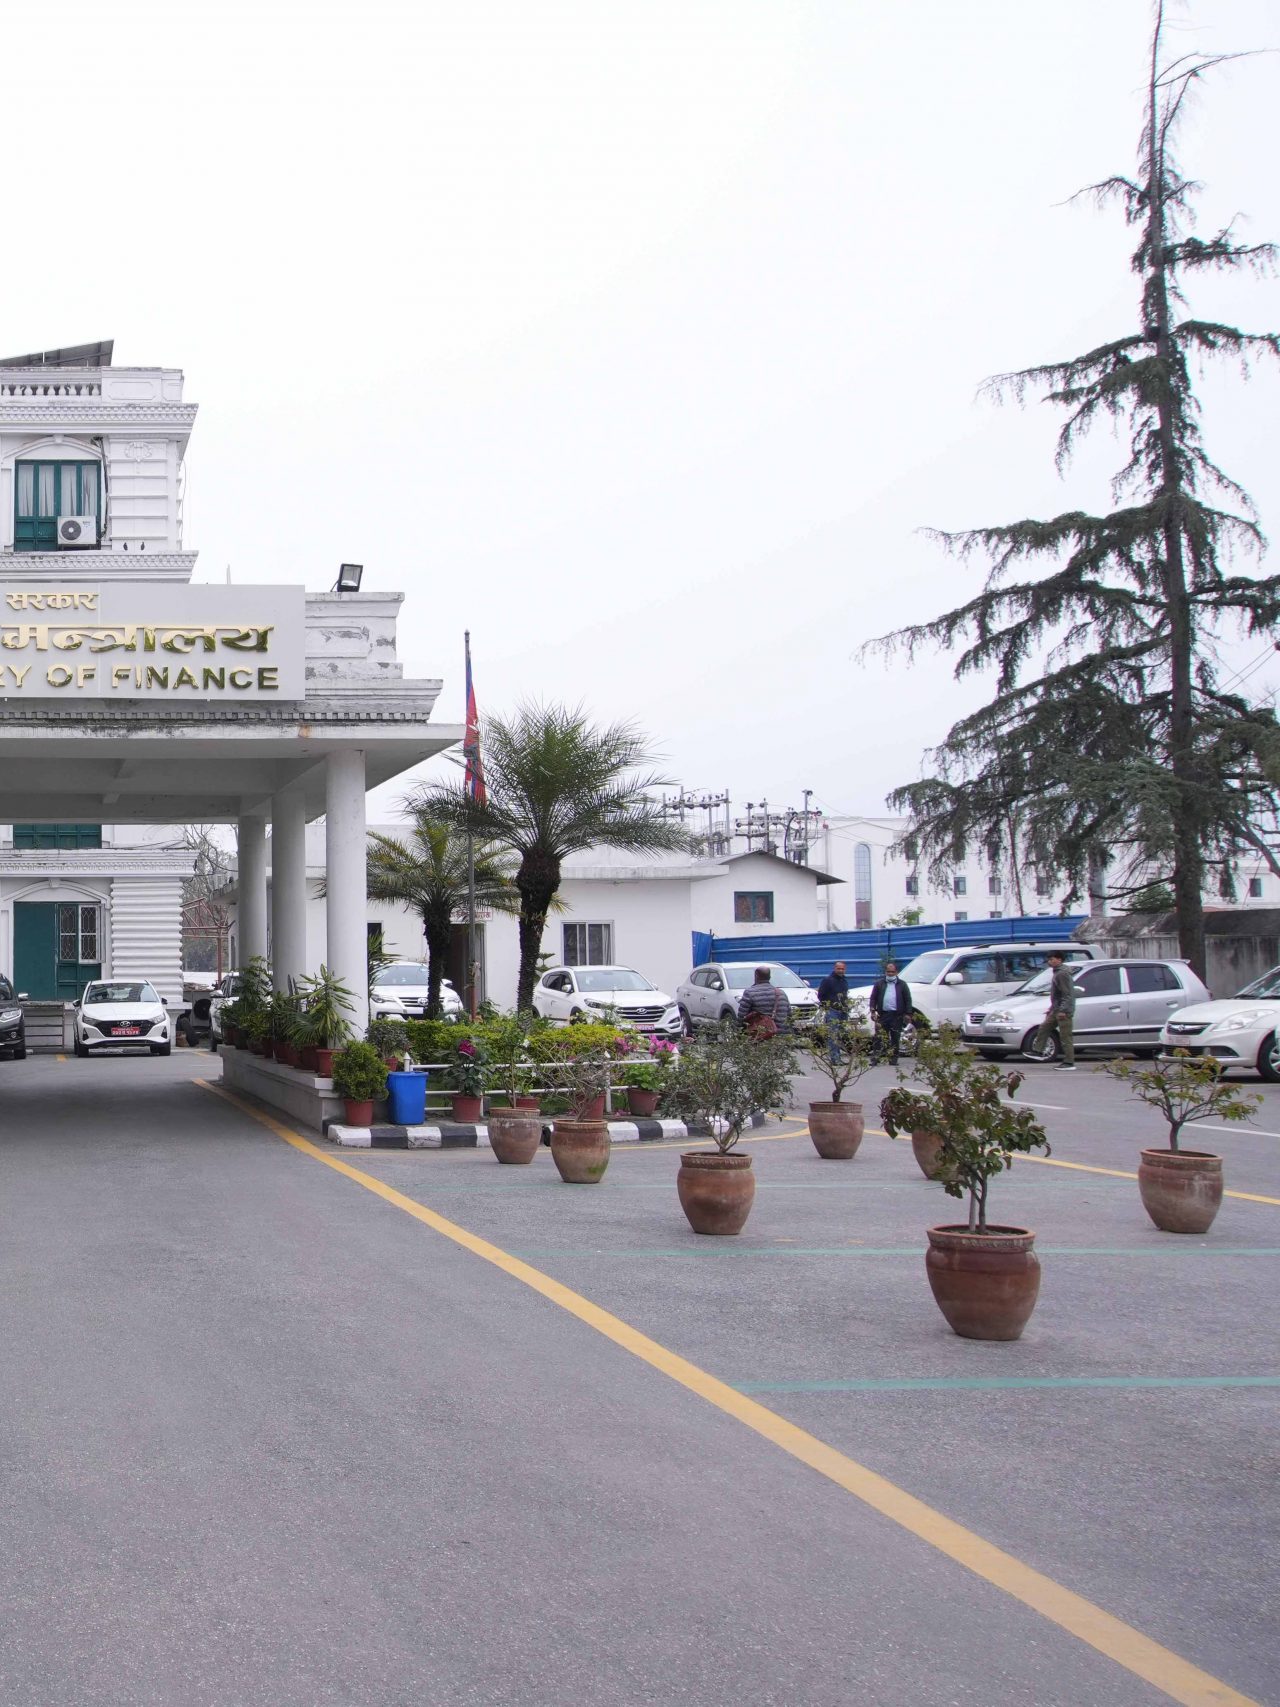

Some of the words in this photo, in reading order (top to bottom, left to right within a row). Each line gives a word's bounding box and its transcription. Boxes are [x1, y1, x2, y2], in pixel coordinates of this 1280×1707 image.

[6, 592, 99, 610] सरकार
[0, 624, 274, 653] मन्त्रालय
[46, 664, 97, 689] OF
[111, 664, 279, 690] FINANCE
